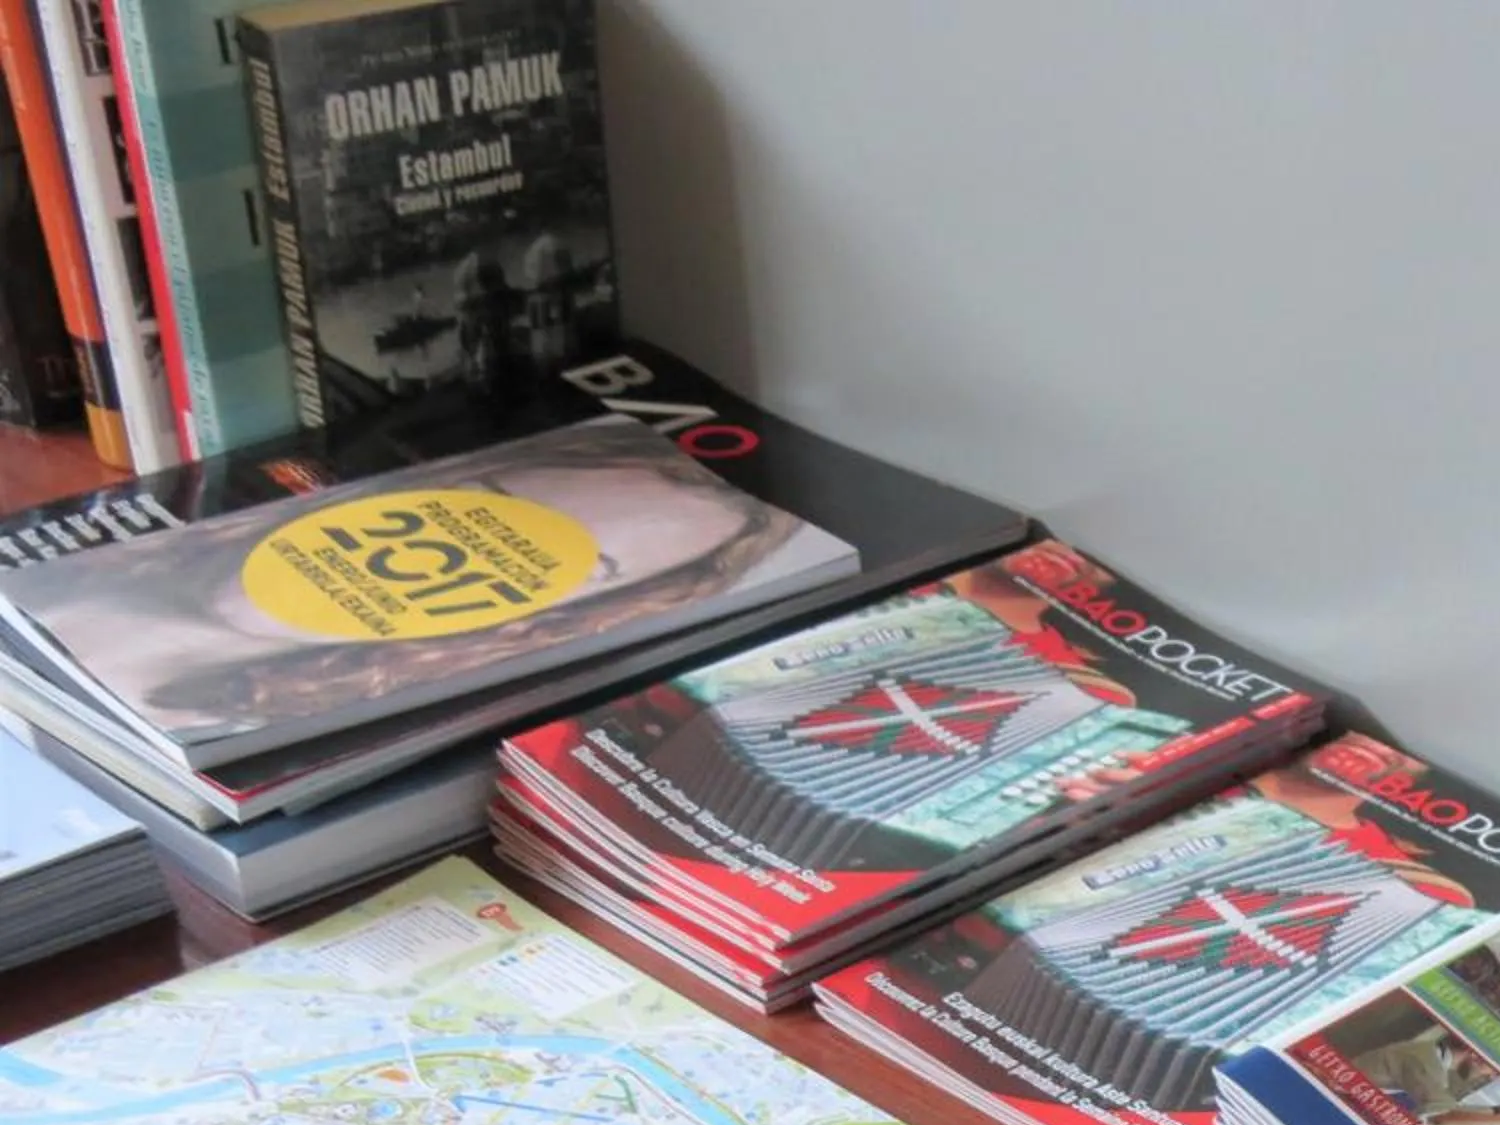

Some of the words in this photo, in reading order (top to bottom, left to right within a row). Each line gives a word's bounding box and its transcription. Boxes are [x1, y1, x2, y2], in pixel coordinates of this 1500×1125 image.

[324, 73, 441, 141] ORHAN
[450, 49, 564, 117] PAMUK
[398, 132, 514, 189] Estambul
[319, 511, 533, 617] 2017
